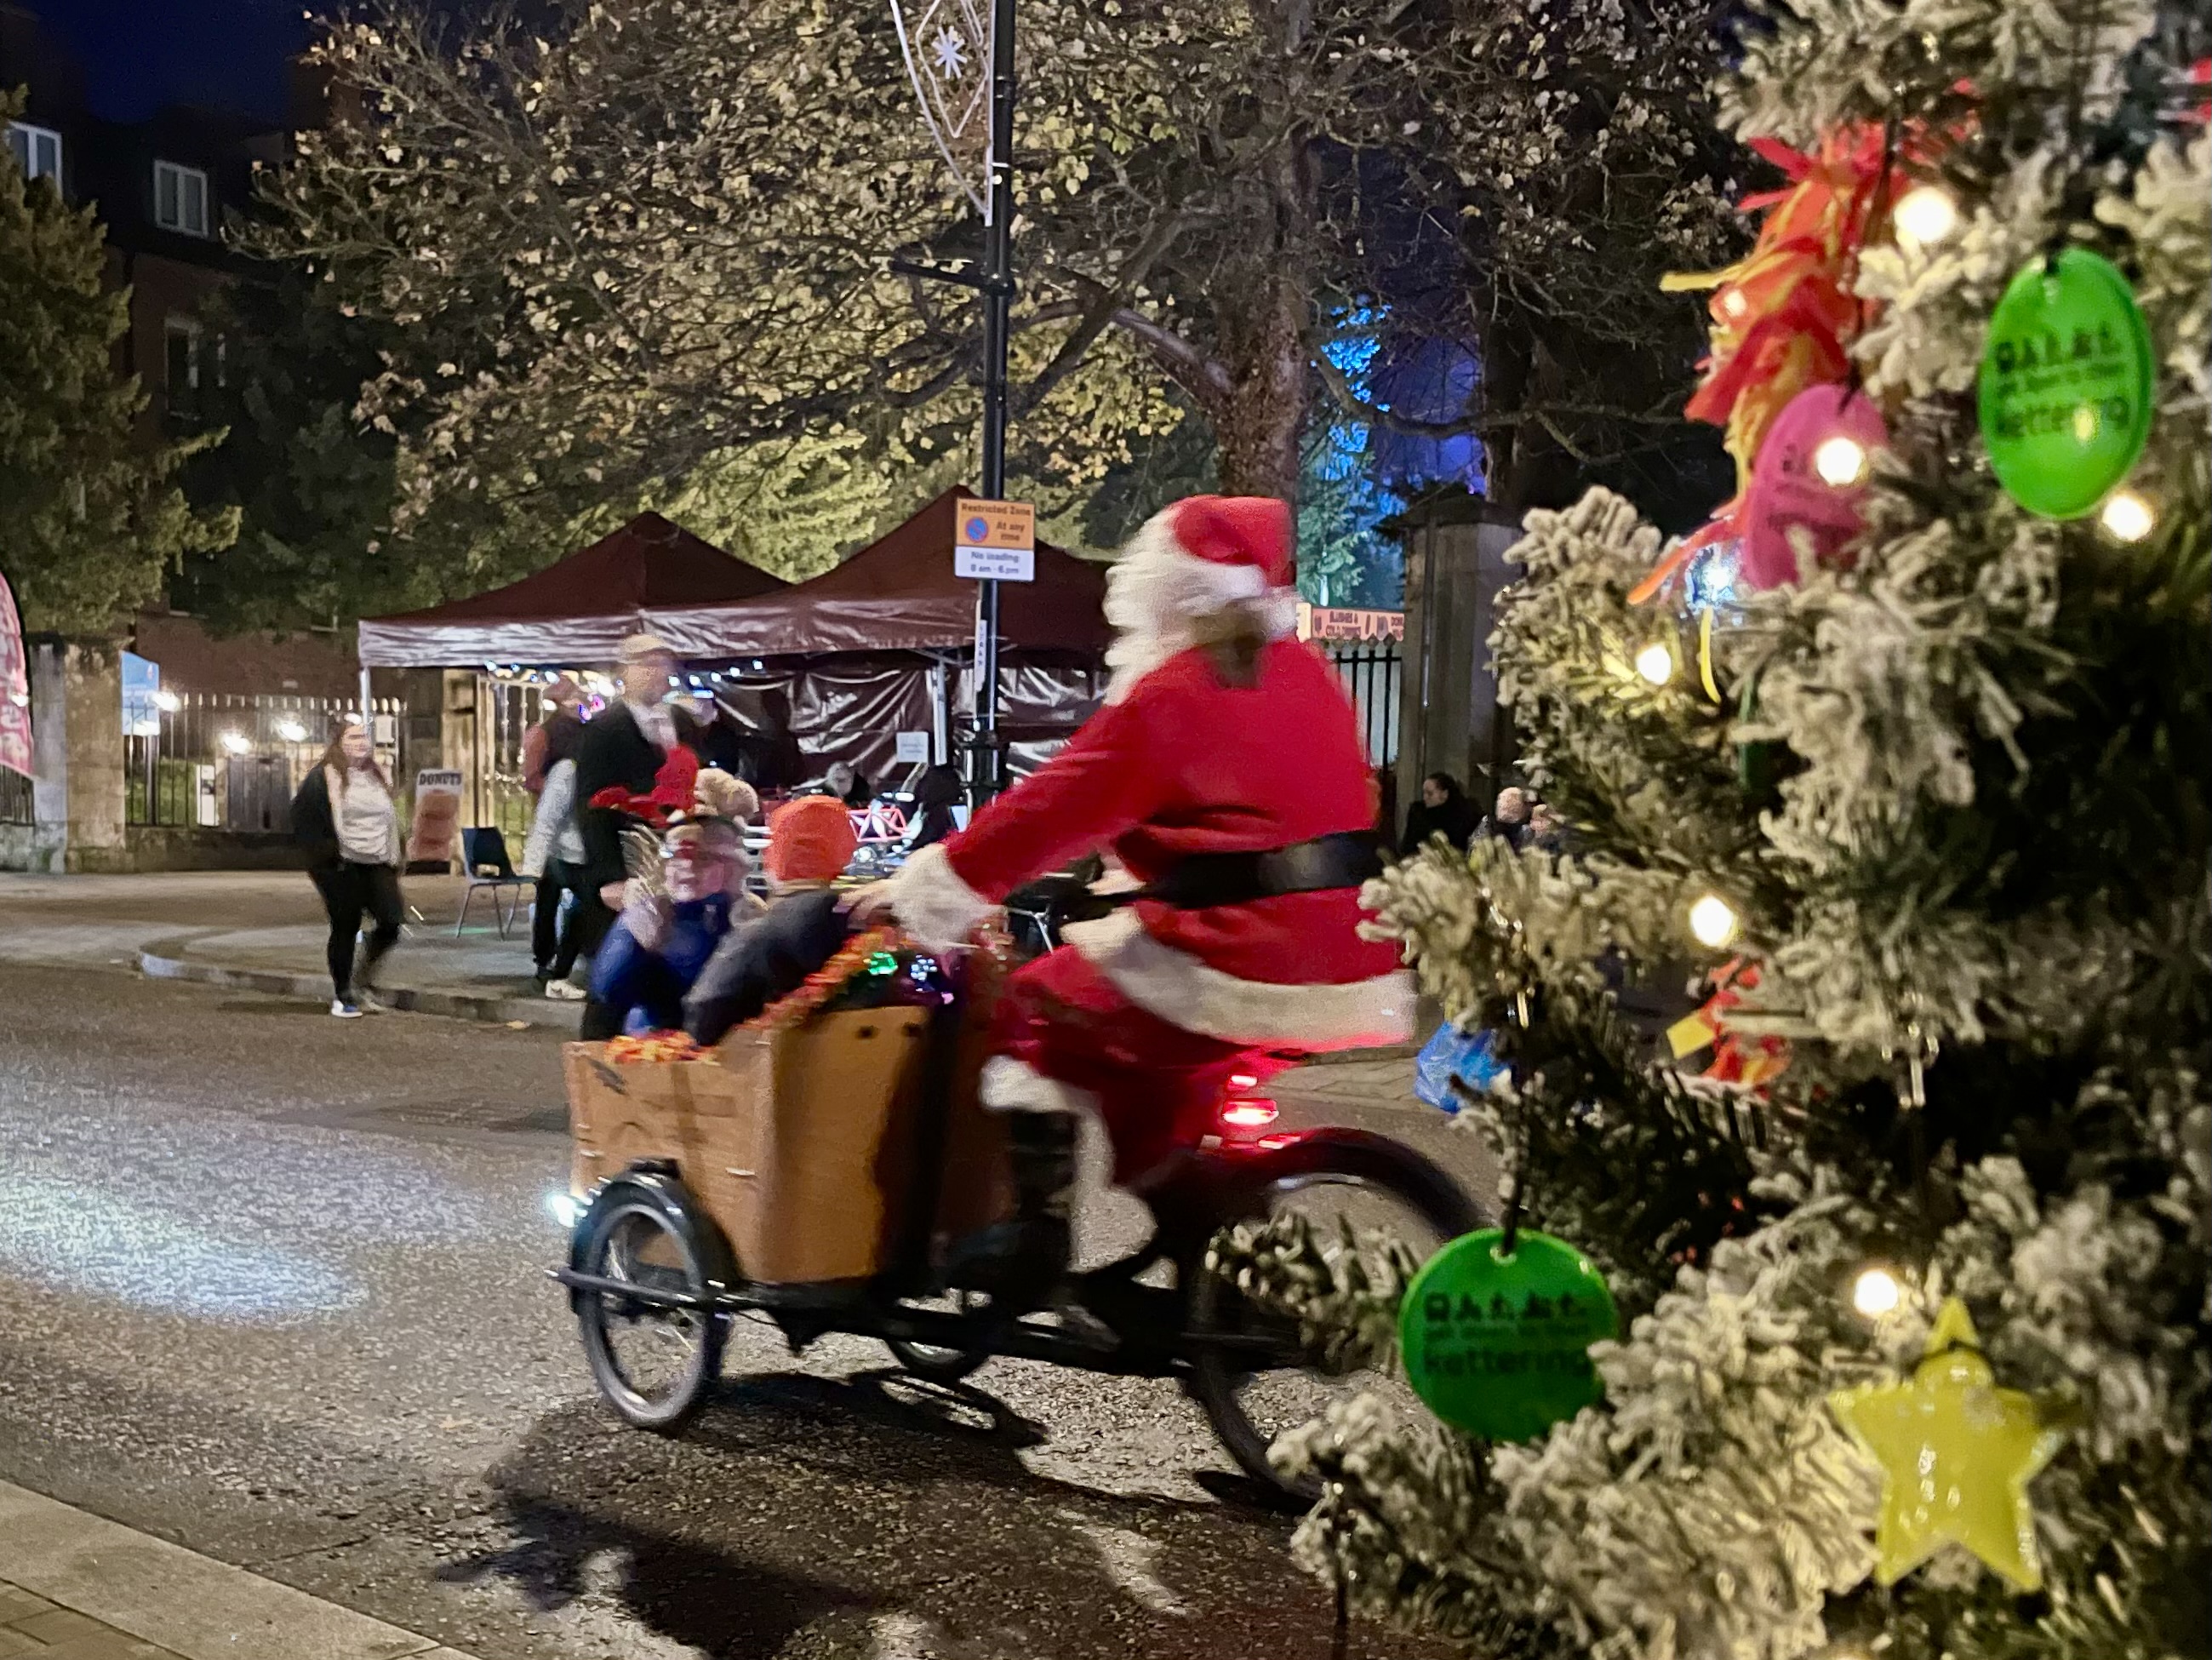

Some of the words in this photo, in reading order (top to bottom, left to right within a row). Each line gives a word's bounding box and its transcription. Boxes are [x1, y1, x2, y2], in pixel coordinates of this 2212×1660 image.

[962, 503, 1008, 514] Restricted
[1010, 506, 1031, 516] Zone
[997, 521, 1007, 529] At
[1009, 524, 1025, 533] any
[971, 551, 984, 559] No
[986, 552, 1020, 563] loading
